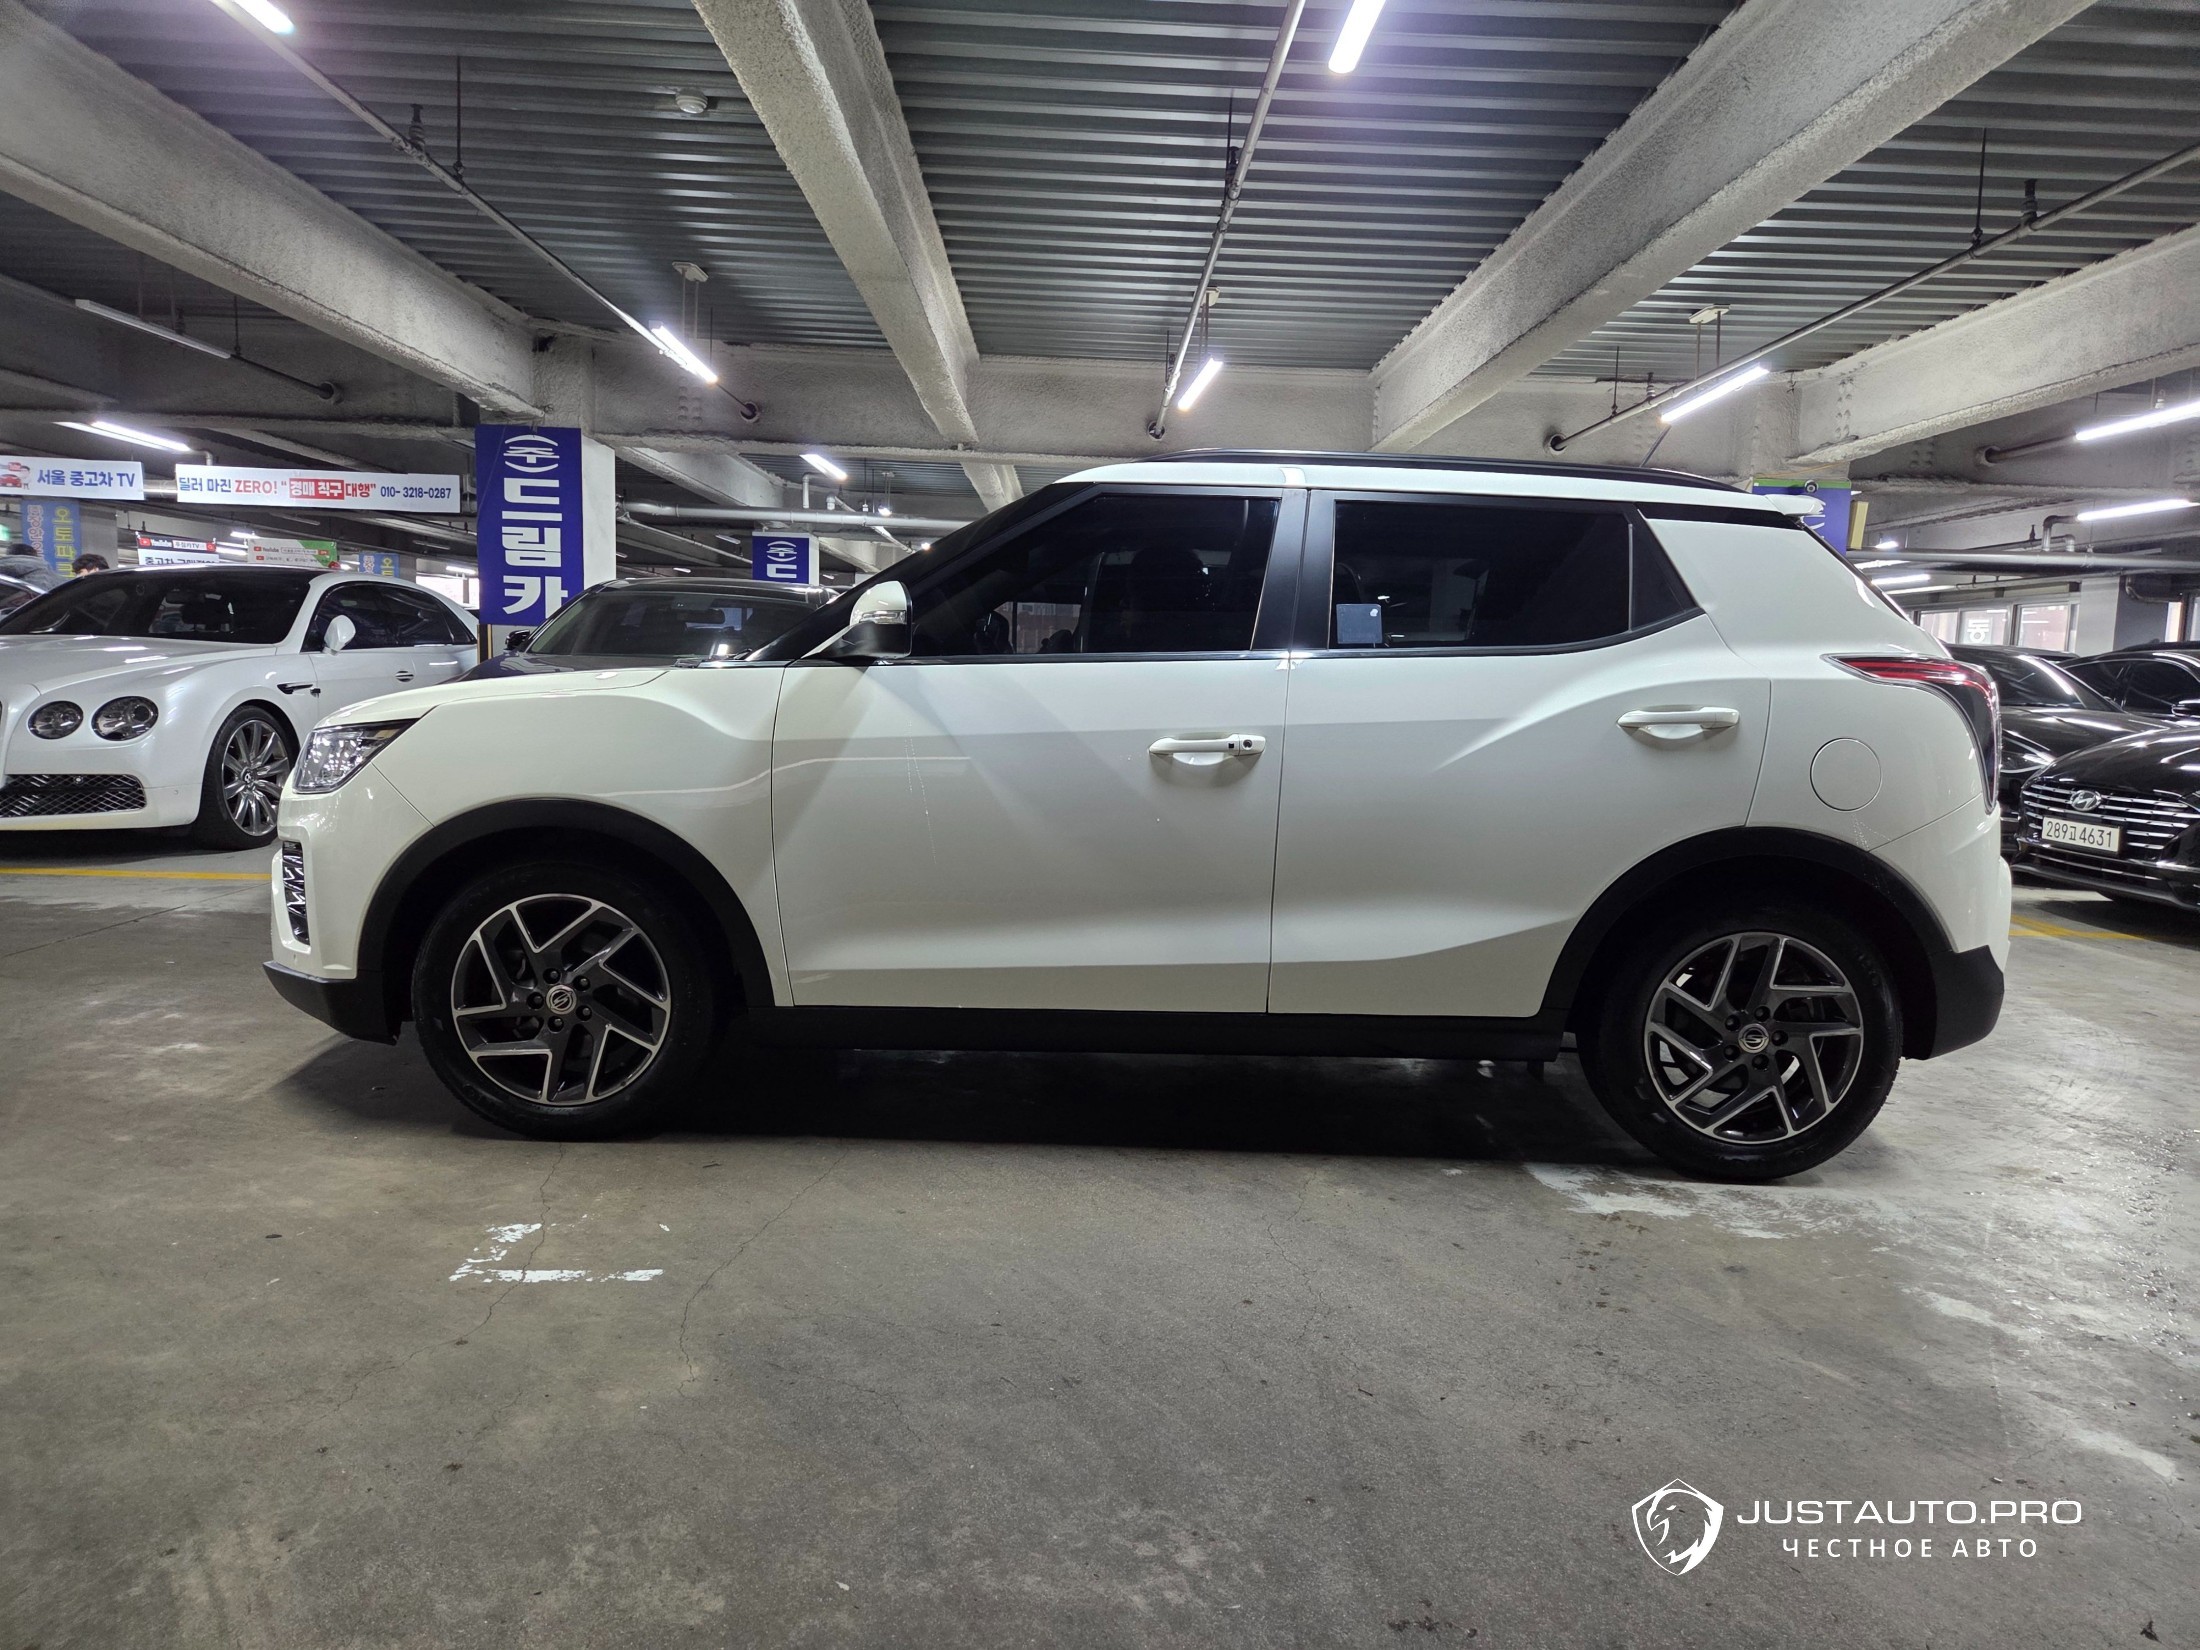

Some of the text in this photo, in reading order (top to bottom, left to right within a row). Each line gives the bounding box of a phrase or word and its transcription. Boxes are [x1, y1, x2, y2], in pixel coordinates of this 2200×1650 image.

[37, 469, 135, 487] 서울 중고차 TV
[178, 477, 203, 492] 딜러
[207, 478, 231, 493] 마진
[234, 480, 277, 495] ZERO!
[318, 481, 343, 497] 직구
[402, 487, 451, 499] 3218-0287
